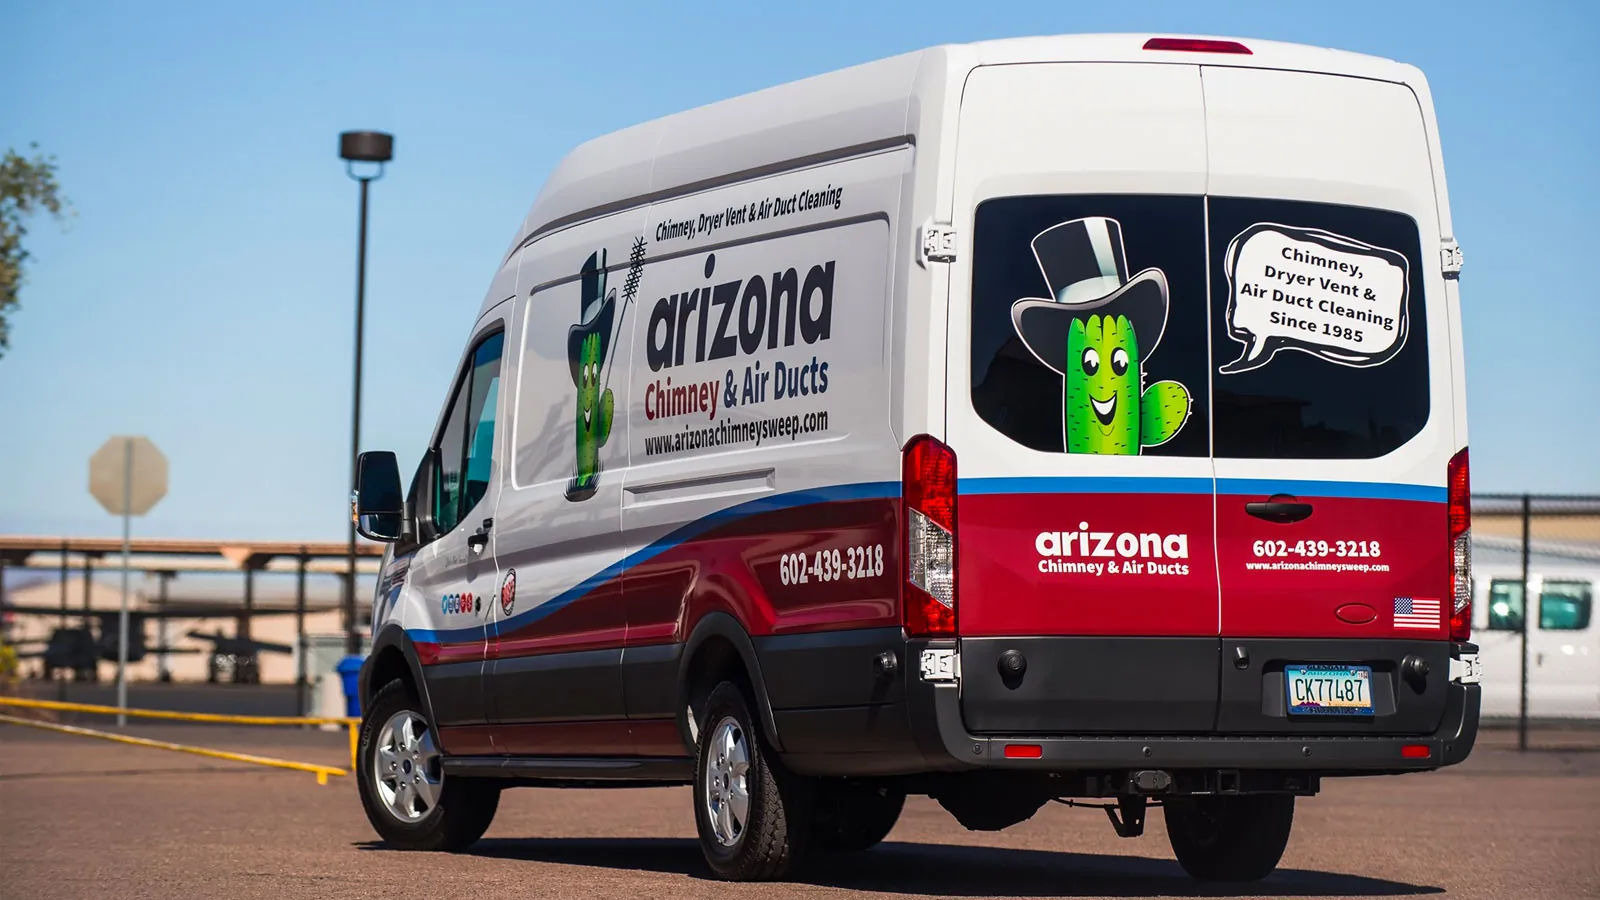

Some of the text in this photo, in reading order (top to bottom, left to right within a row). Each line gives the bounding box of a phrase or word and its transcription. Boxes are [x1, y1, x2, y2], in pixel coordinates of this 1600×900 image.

[656, 184, 843, 241] Chimney, Dryer Vent & Air Duct Cleaning
[1281, 247, 1364, 279] Chimney,
[1264, 265, 1377, 301] Dryer Vent &
[647, 253, 836, 372] arizona
[1240, 283, 1394, 331] Air Duct Cleaning
[1269, 311, 1364, 343] Since 1985
[645, 356, 829, 420] Chimney & Air Ducts
[645, 410, 829, 455] www.arizonachimneysweep.com
[1035, 521, 1189, 559] arizona
[1253, 540, 1381, 558] 602-439-3218
[780, 543, 884, 586] 602-439-3218
[1038, 559, 1189, 576] Chimney & Air Ducts
[1246, 561, 1390, 573] www.arizonachimneysweep.com
[1295, 678, 1363, 702] CK77487
